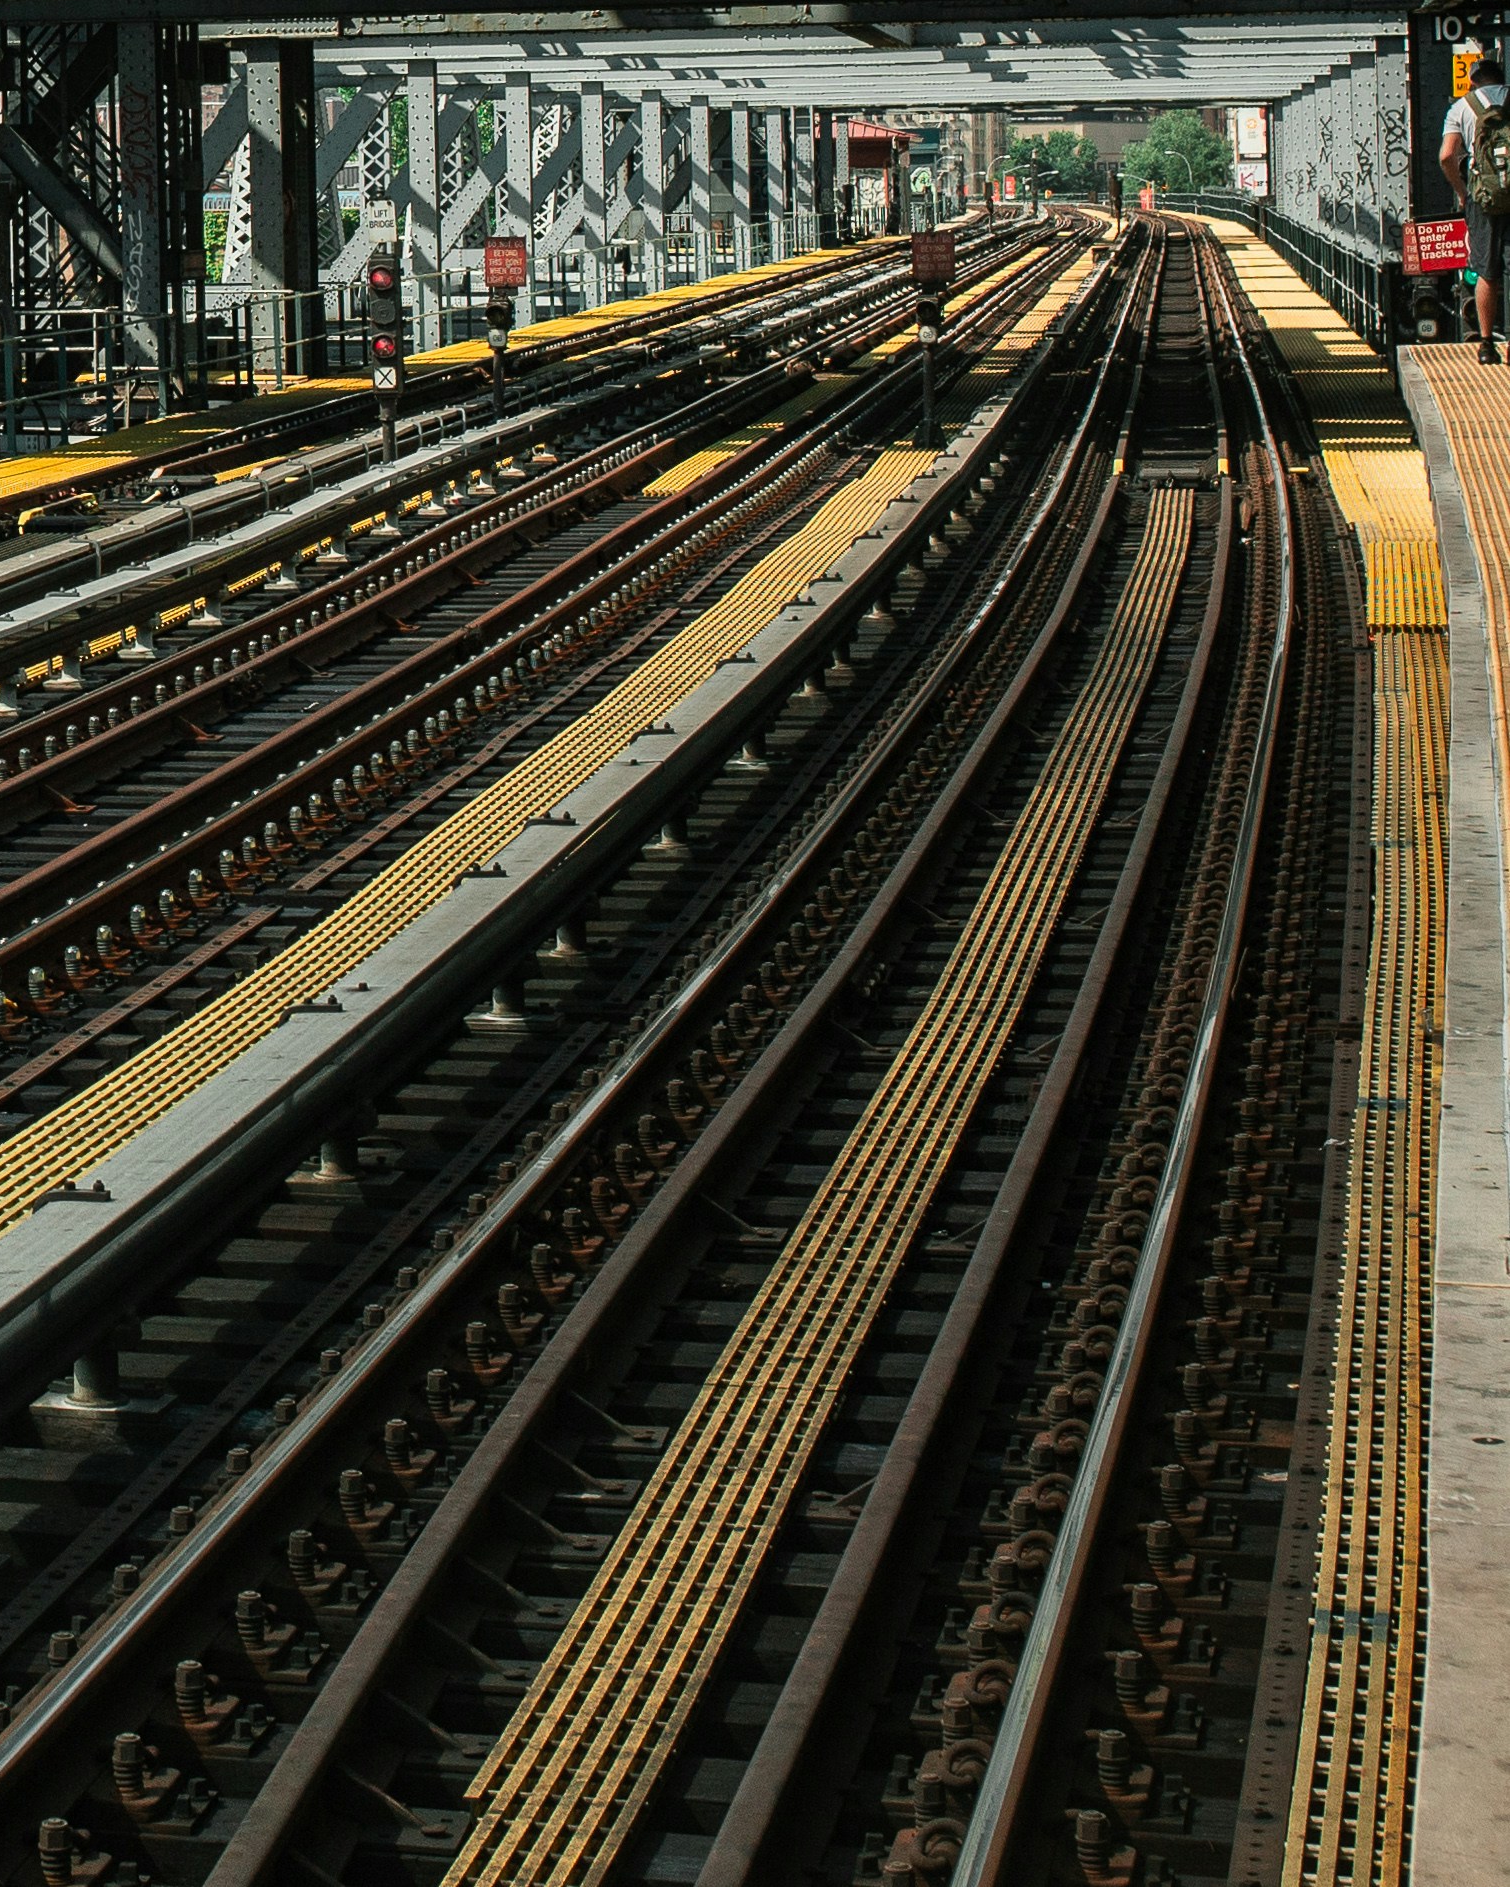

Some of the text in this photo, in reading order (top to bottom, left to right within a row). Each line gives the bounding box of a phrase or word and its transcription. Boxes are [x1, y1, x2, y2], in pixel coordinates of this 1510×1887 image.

[1435, 16, 1463, 41] 10
[373, 209, 387, 218] LIFT
[369, 219, 395, 228] BRIDGE
[1418, 223, 1454, 235] Do not
[1419, 233, 1447, 243] enter
[1435, 240, 1465, 250] cross
[1421, 250, 1455, 260] tracks
